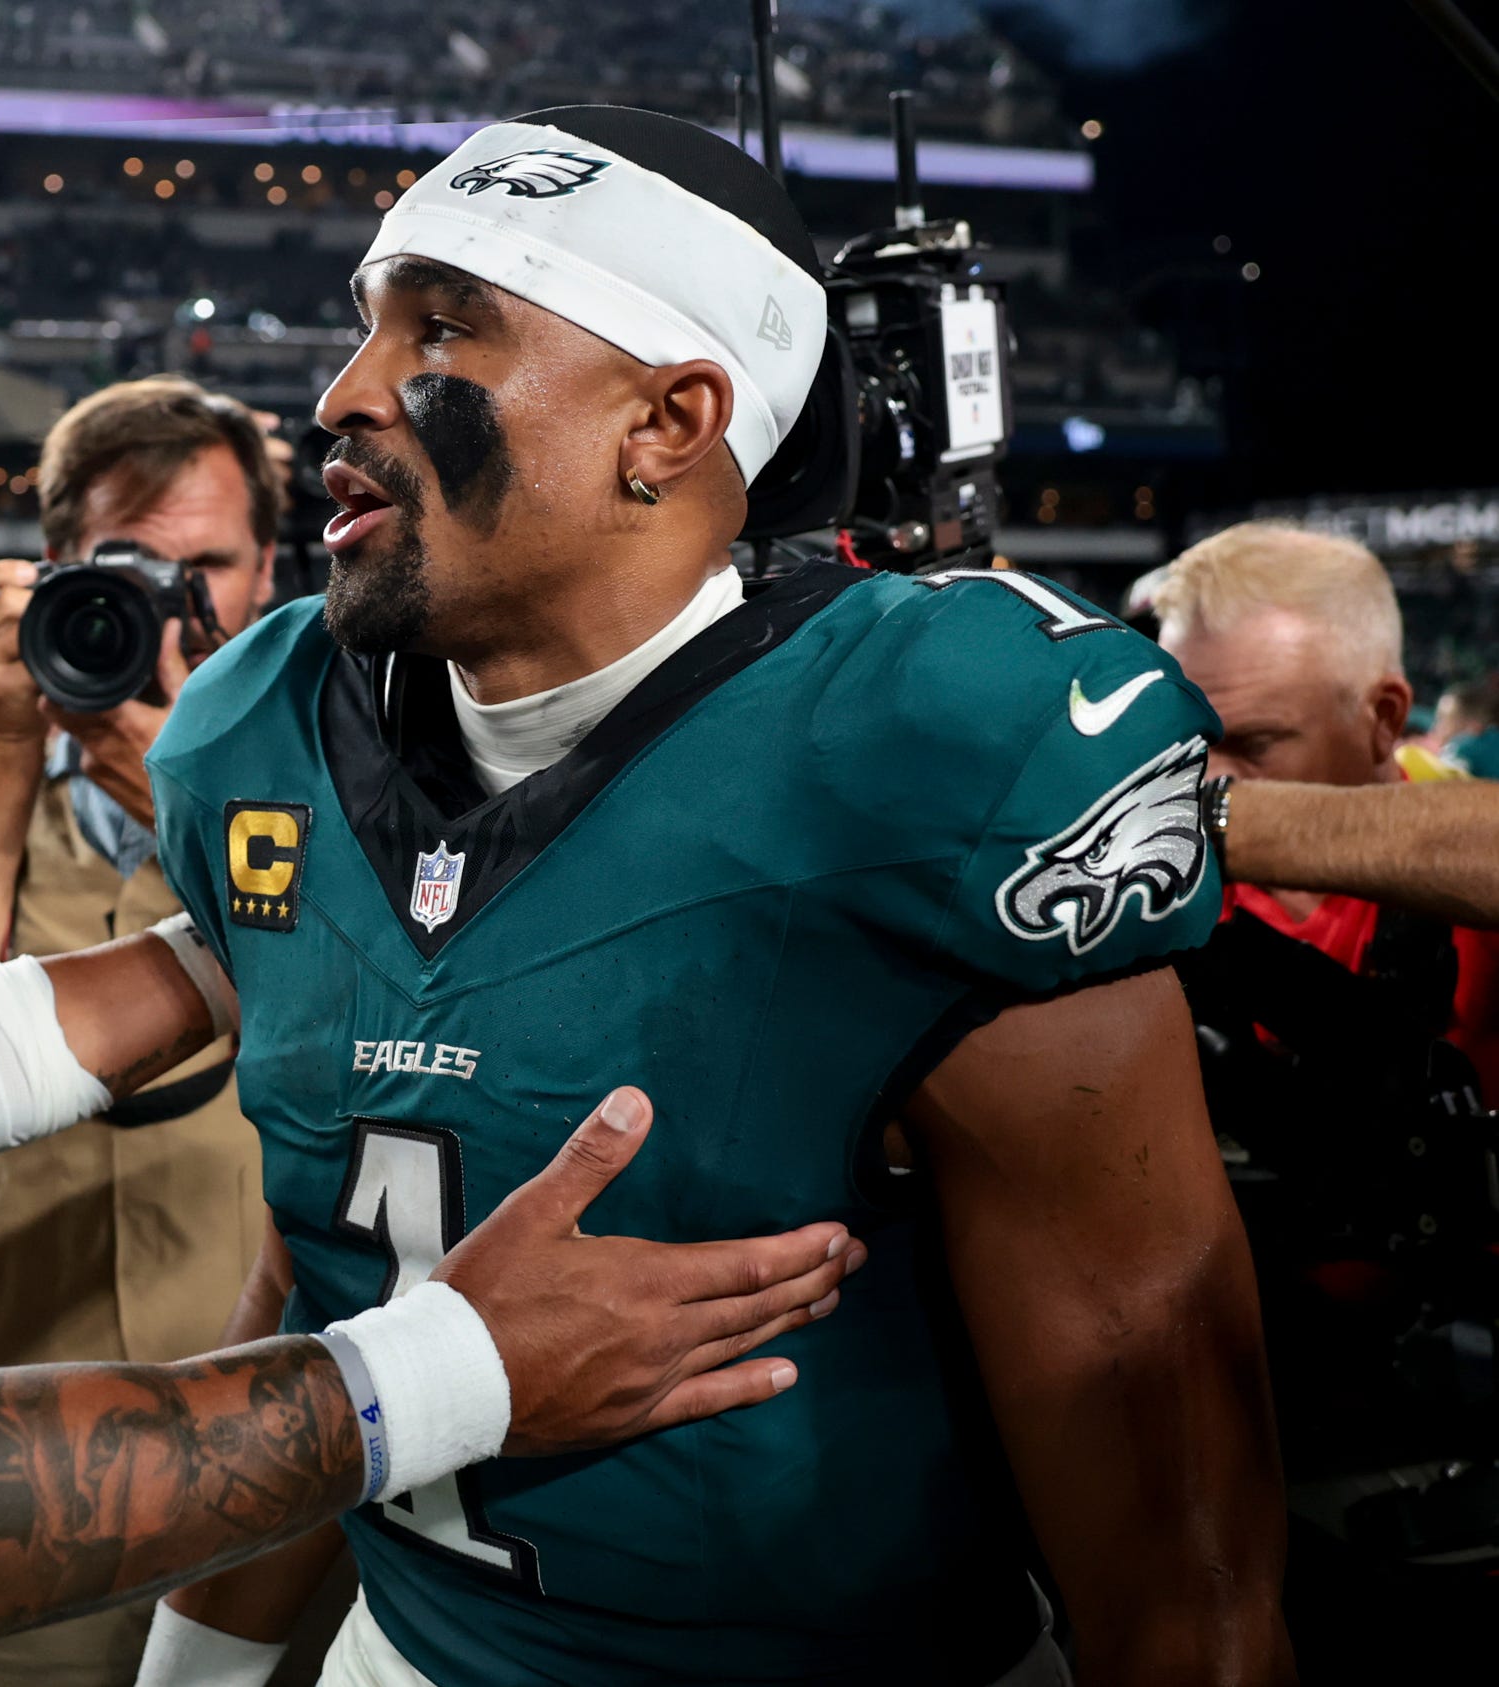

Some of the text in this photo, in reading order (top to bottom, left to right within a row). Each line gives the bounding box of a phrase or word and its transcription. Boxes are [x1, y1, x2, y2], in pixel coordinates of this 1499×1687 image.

[915, 569, 1124, 641] 1
[228, 810, 298, 896] C
[419, 882, 449, 912] NFL
[353, 1040, 482, 1080] EAGLES
[333, 1116, 540, 1592] 1
[360, 1395, 382, 1424] 4
